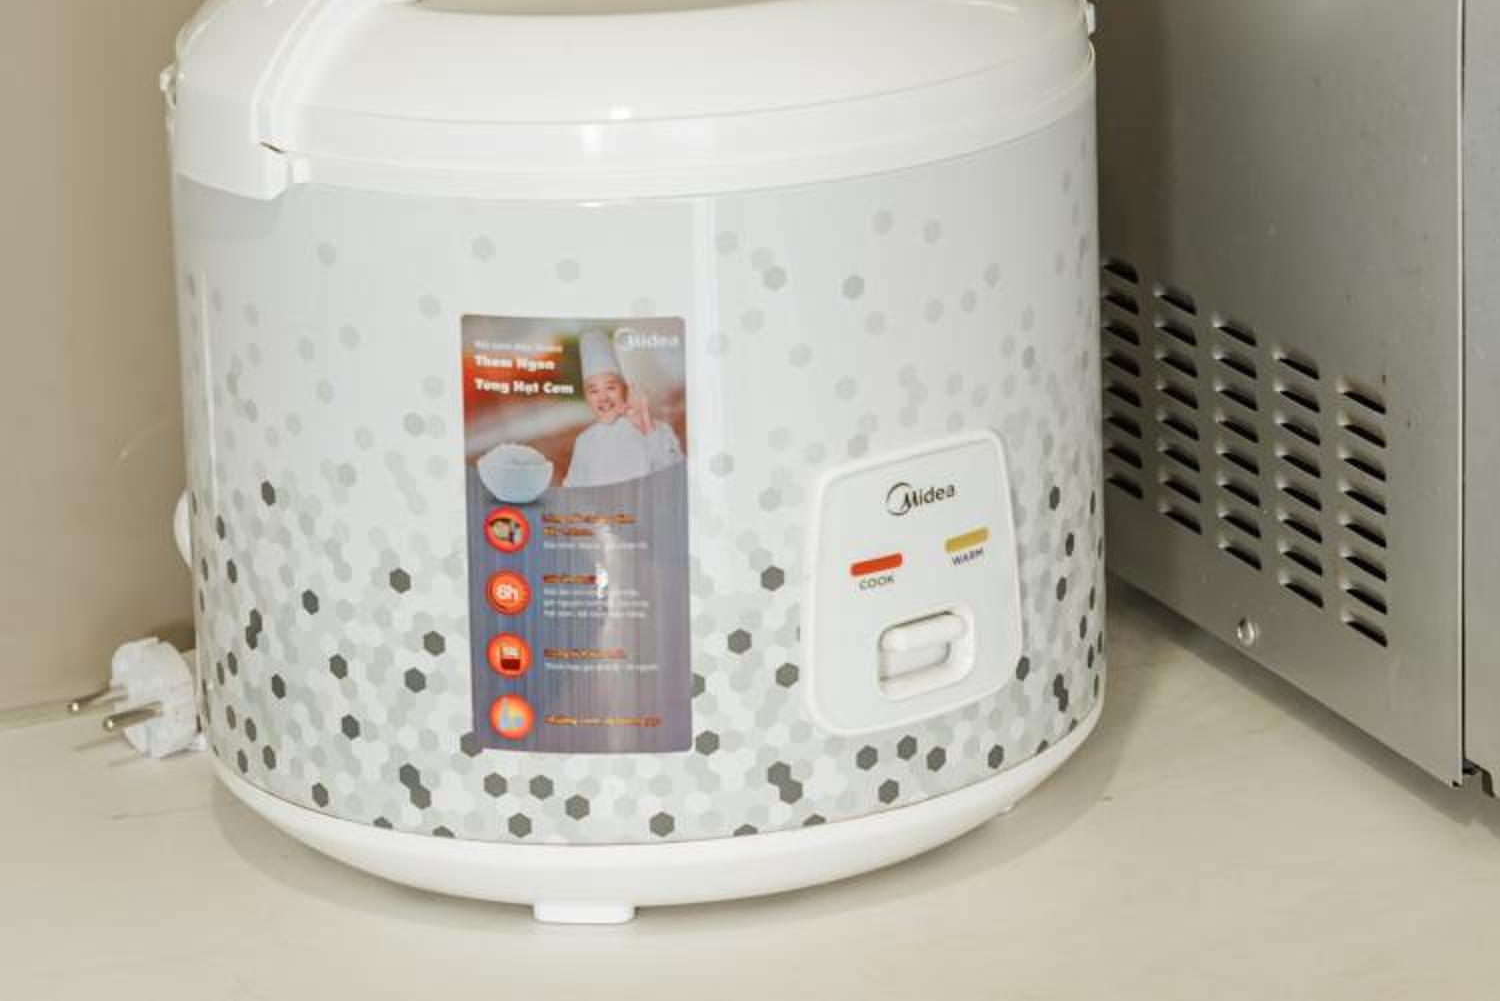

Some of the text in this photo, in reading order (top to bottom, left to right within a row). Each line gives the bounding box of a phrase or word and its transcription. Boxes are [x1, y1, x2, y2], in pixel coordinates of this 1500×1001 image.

[886, 483, 956, 515] Midea
[951, 547, 984, 566] WARM
[859, 574, 895, 590] COOK
